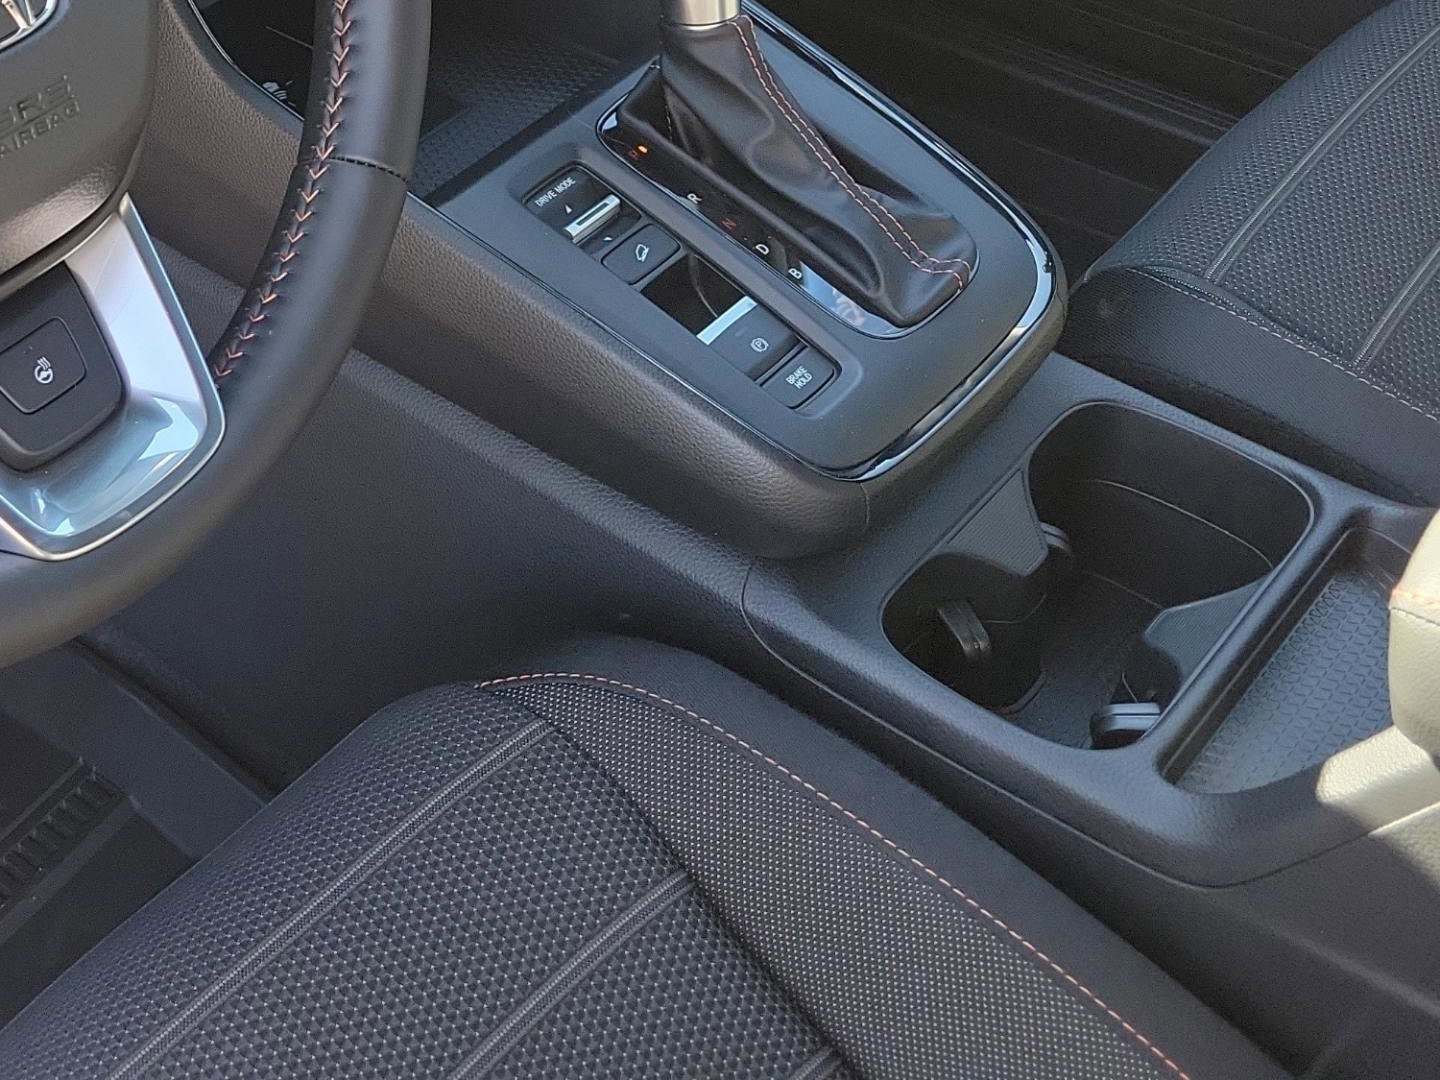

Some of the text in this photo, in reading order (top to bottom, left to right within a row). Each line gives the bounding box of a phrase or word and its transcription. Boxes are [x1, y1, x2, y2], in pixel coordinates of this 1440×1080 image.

[534, 177, 576, 208] DRIVE MODE
[687, 193, 702, 204] R
[721, 218, 737, 230] N
[755, 243, 770, 255] D
[788, 268, 802, 280] B
[785, 365, 808, 385] BRAKE
[794, 372, 813, 390] HOLD
